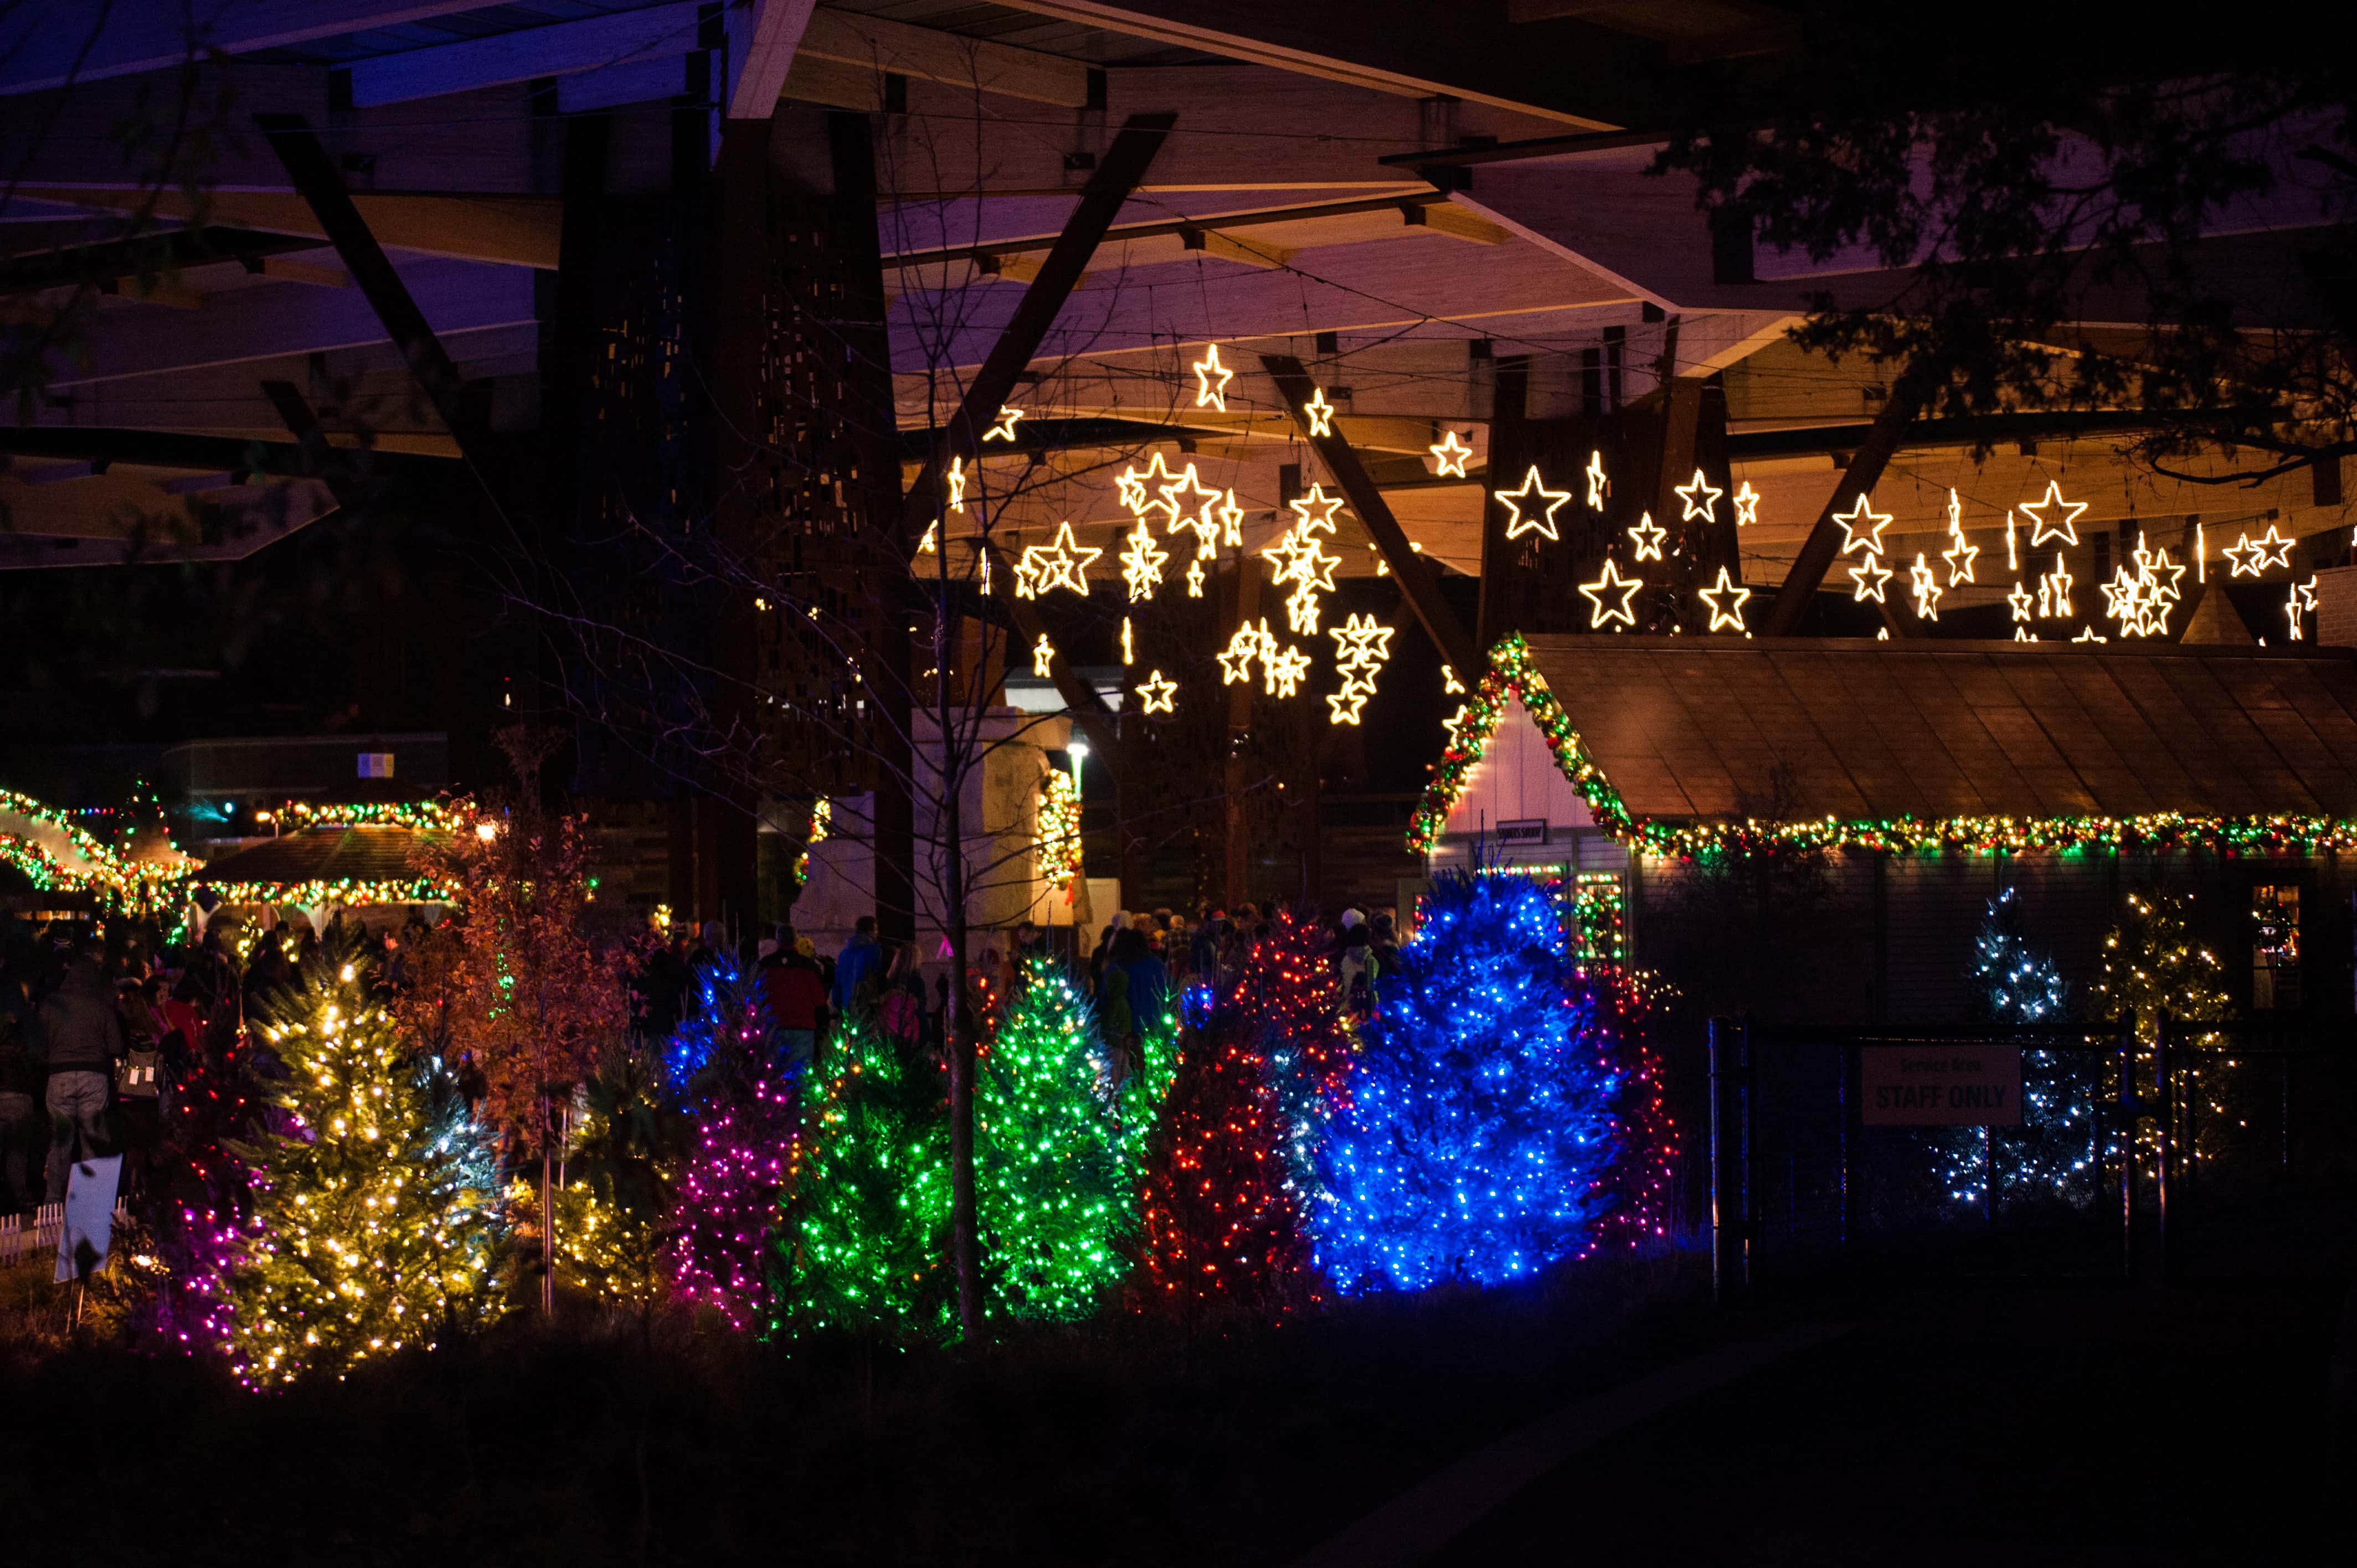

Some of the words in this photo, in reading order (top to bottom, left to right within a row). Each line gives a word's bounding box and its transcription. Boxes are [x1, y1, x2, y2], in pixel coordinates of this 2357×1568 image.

[1952, 1058, 1982, 1072] Area
[1877, 1085, 1941, 1108] STAFF
[1949, 1085, 2006, 1108] ONLY
